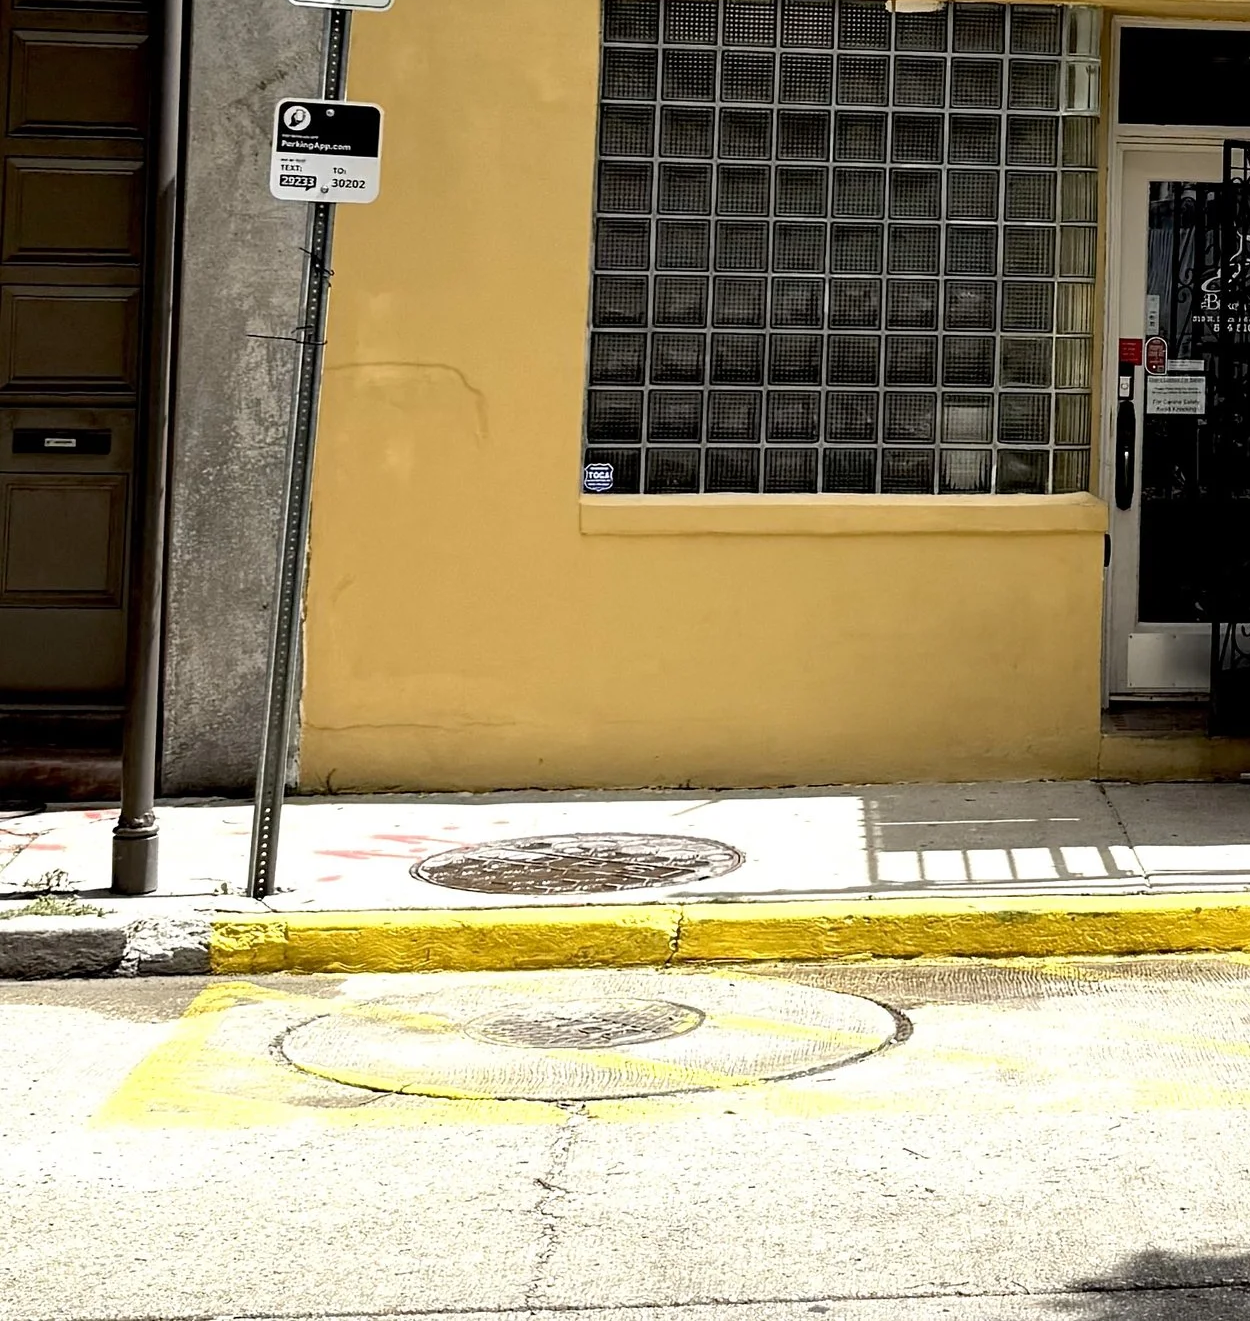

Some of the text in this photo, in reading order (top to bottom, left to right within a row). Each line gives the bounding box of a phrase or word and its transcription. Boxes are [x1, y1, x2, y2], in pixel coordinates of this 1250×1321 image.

[281, 140, 351, 151] ParkingApp.com
[281, 176, 366, 189] 29233 30202
